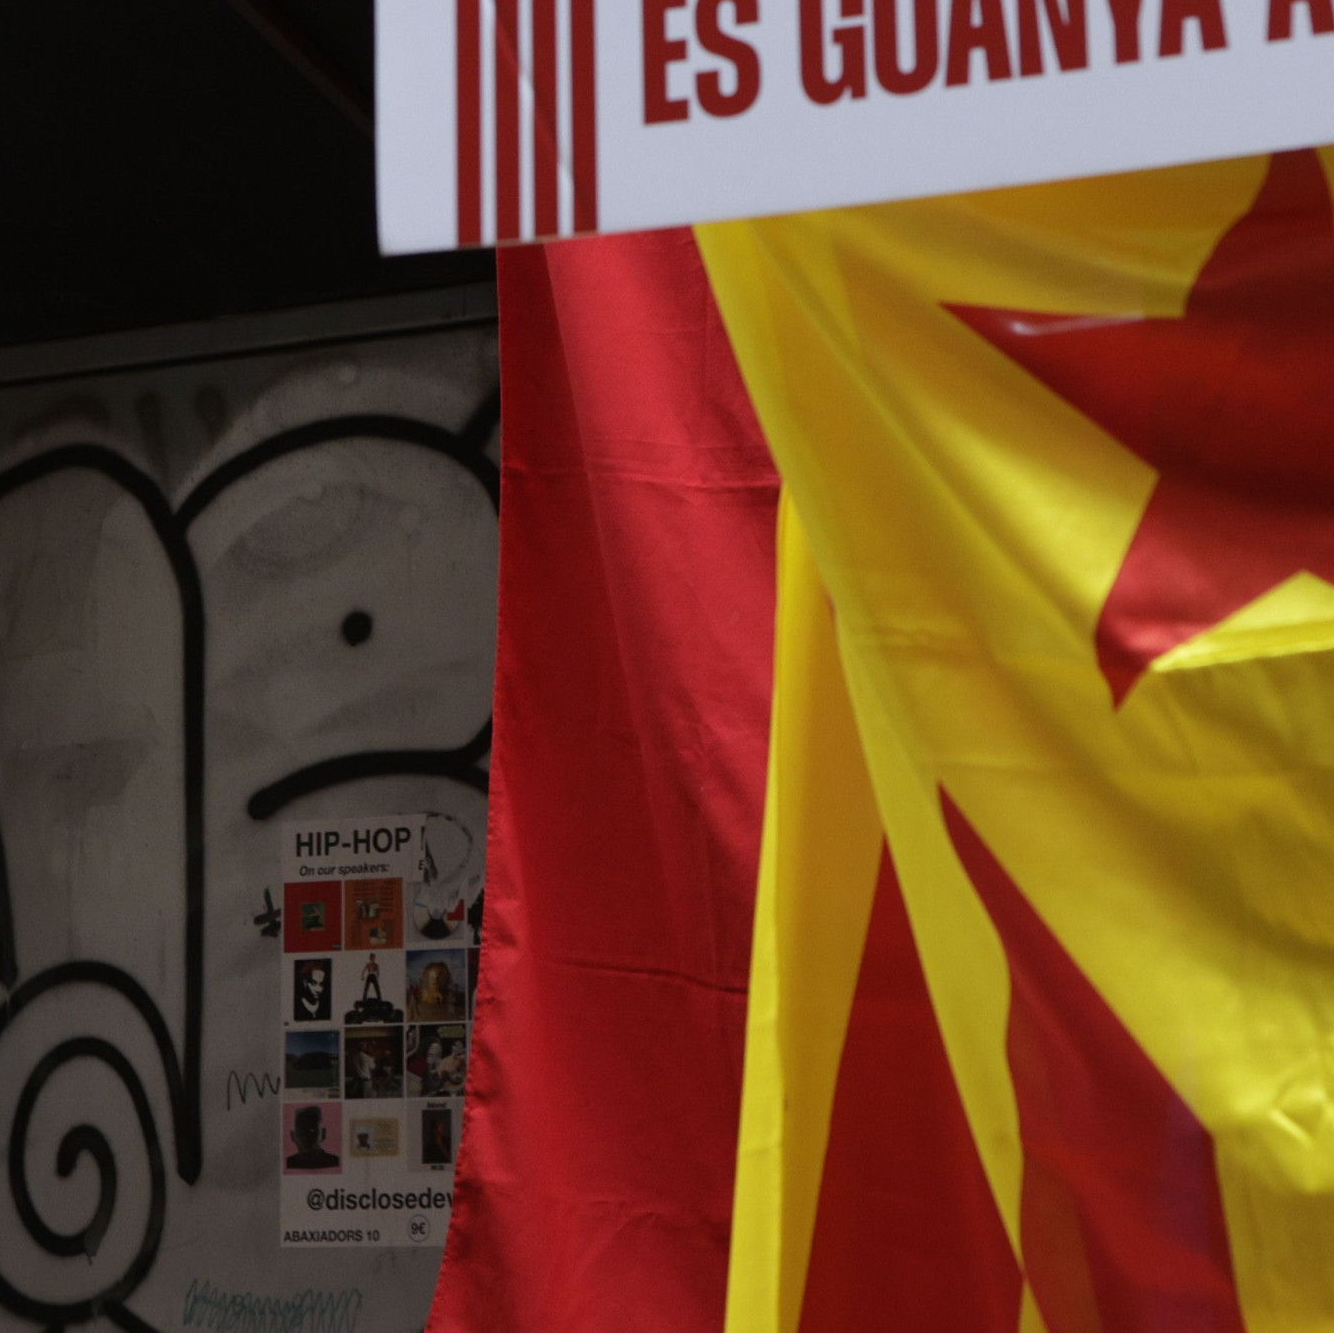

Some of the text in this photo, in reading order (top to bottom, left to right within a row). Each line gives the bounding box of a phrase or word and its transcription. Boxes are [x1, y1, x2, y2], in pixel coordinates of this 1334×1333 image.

[296, 827, 411, 858] HIP-HOP
[299, 865, 315, 877] On
[318, 865, 335, 876] our
[366, 1230, 380, 1243] 10
